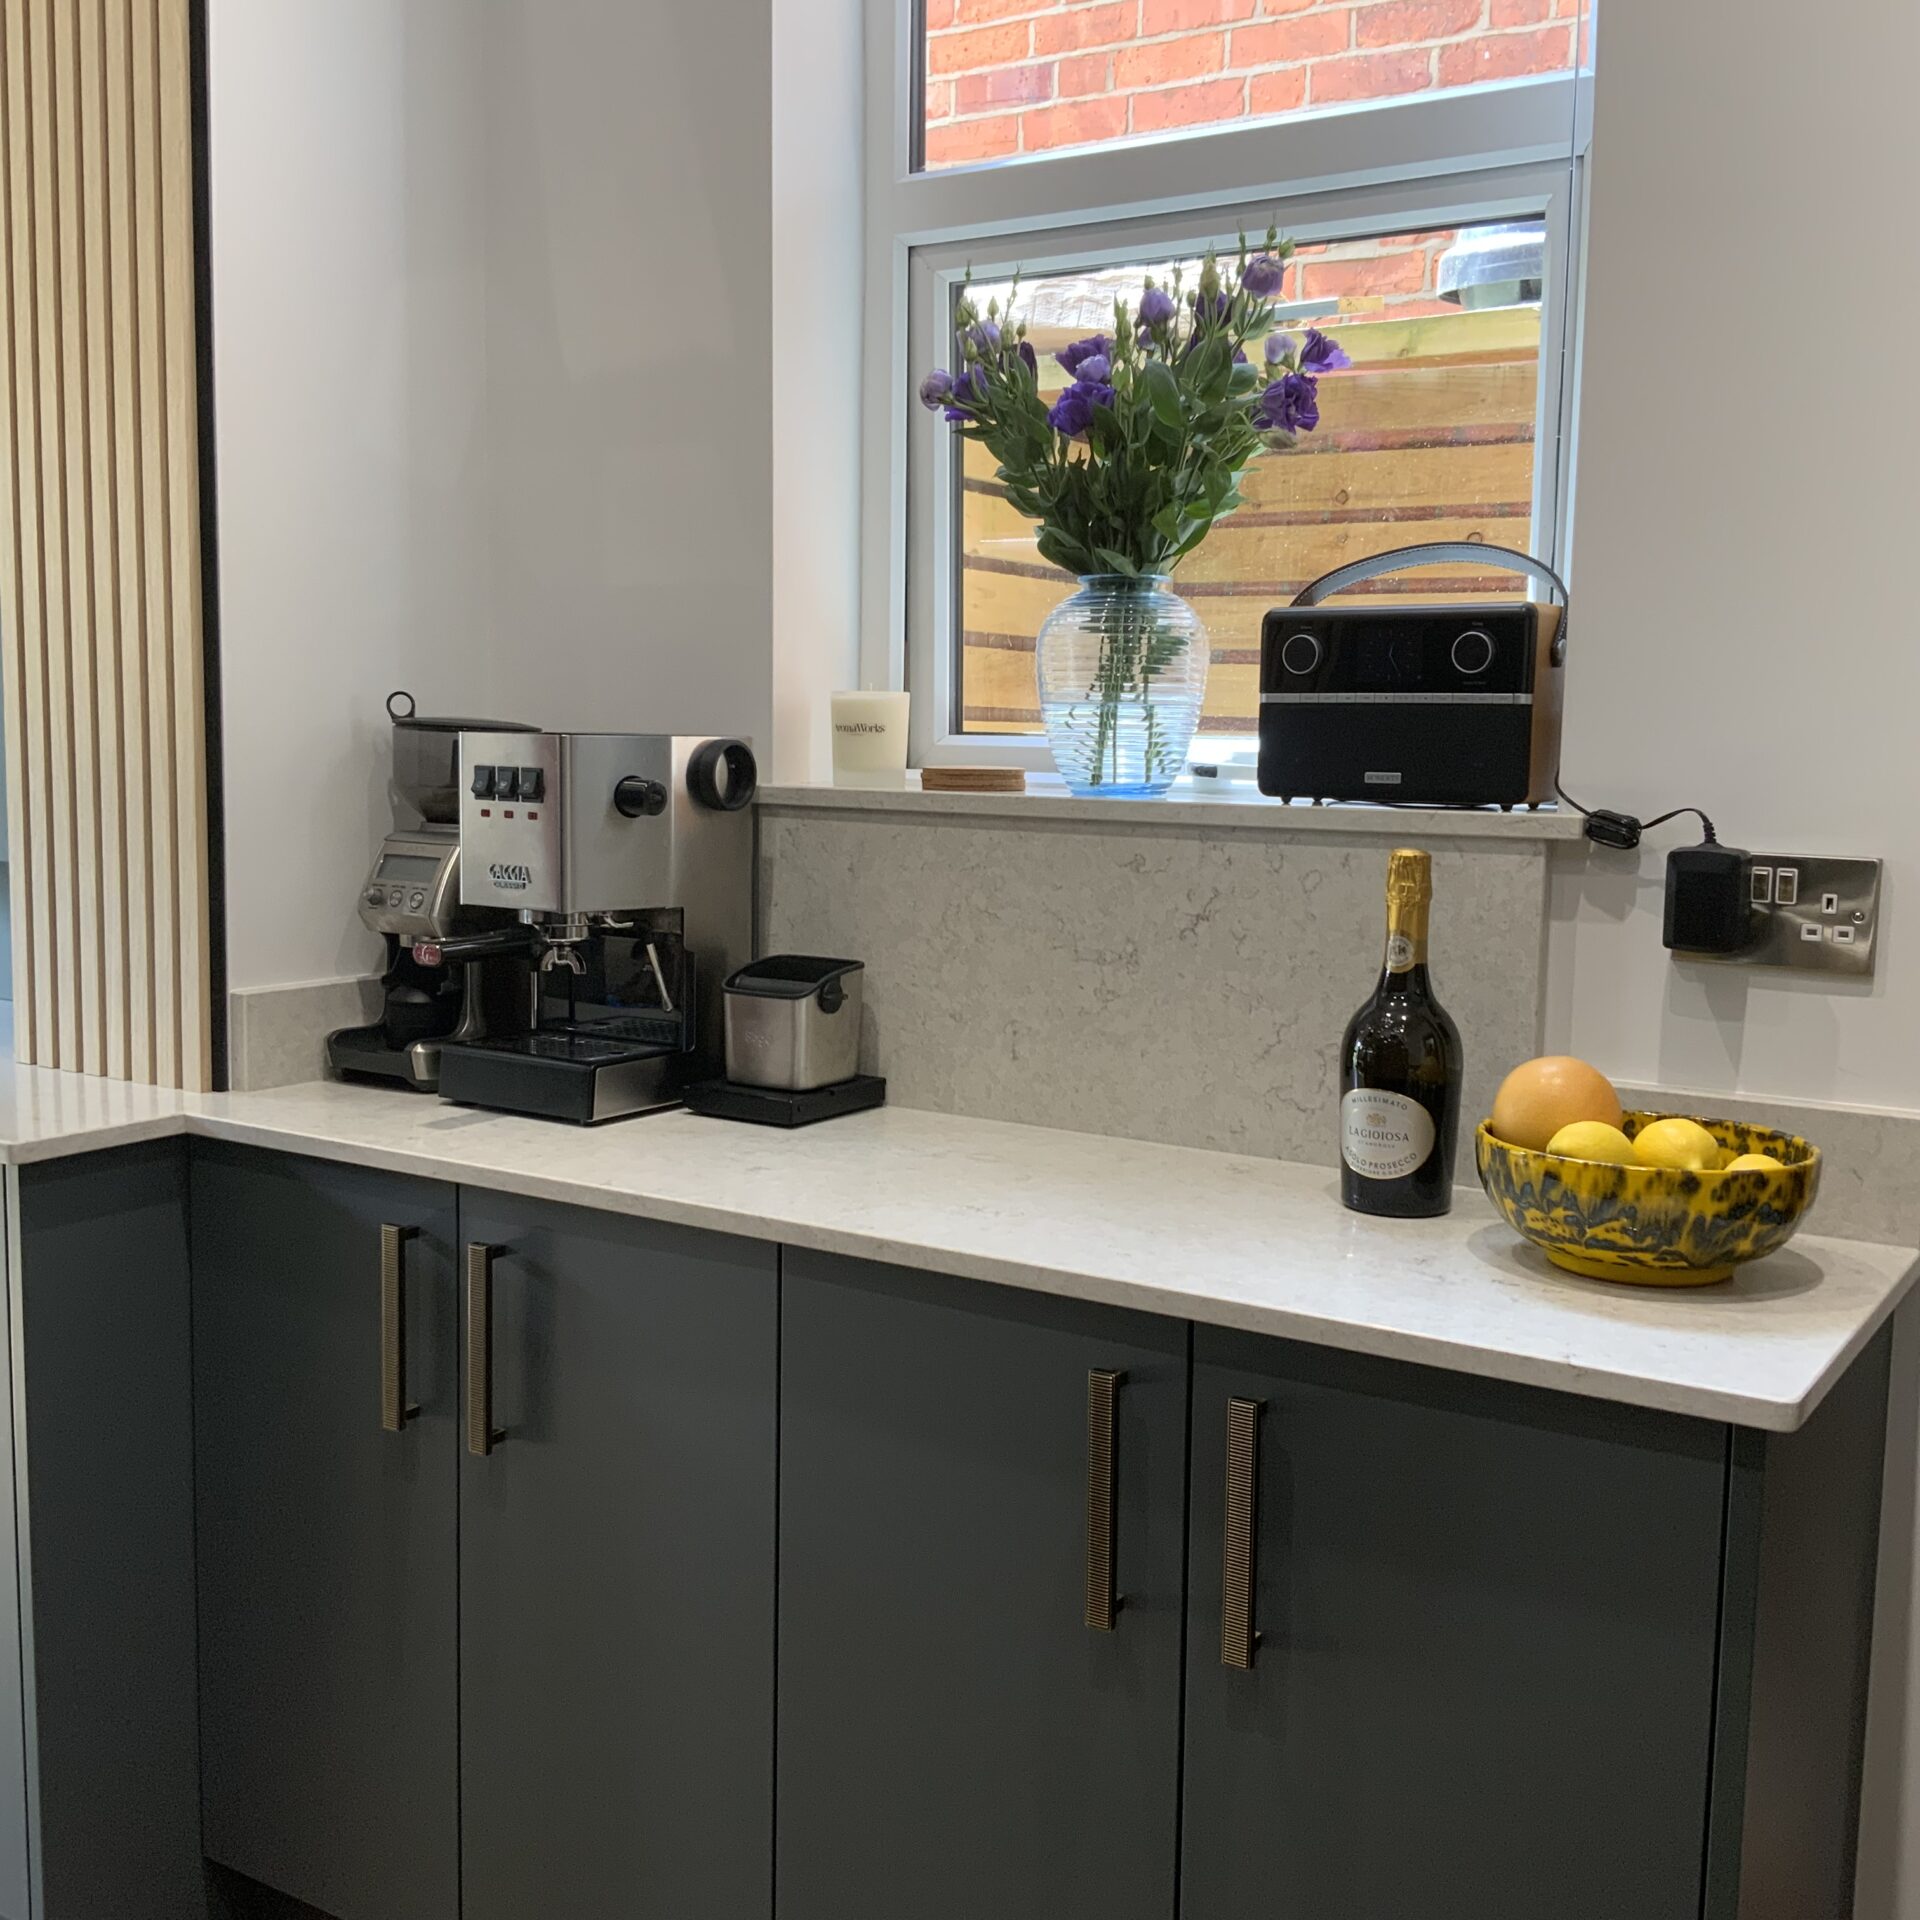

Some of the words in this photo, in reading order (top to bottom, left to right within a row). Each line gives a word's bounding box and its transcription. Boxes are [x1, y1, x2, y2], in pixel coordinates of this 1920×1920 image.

[489, 864, 532, 884] GAGGIA
[1351, 1095, 1408, 1111] MILLESIMATO
[1368, 1152, 1417, 1170] PROSECCO
